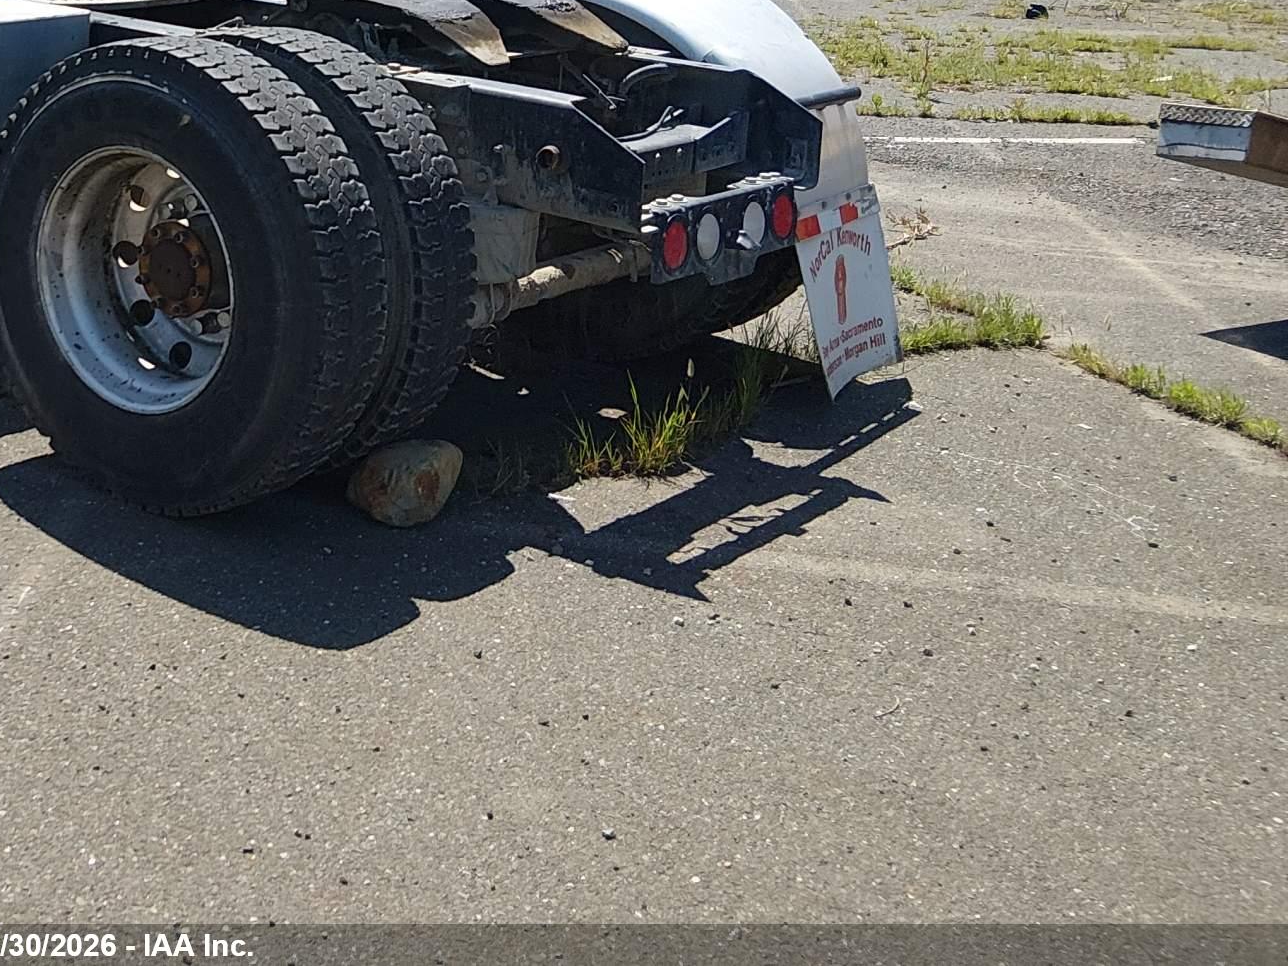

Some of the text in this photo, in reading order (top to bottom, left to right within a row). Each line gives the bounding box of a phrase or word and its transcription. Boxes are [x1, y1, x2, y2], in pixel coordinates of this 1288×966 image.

[809, 226, 871, 282] NorCal Kenworth
[844, 340, 868, 361] Morgan
[869, 332, 886, 349] Hill
